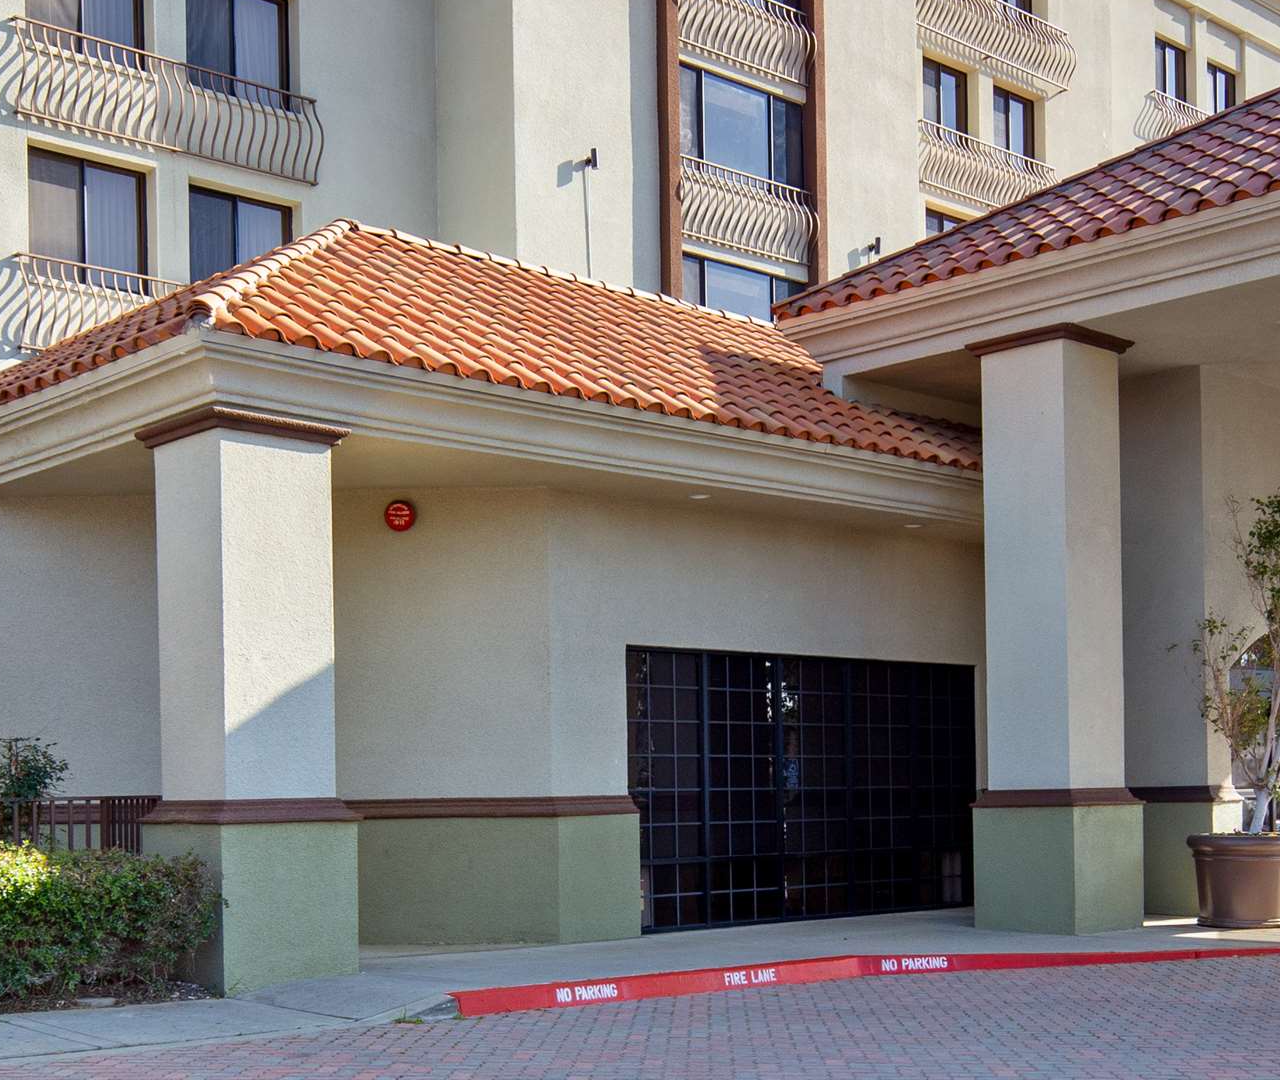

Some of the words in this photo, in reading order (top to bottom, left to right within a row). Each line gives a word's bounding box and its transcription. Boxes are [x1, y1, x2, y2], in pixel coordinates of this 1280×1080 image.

[881, 958, 898, 972] NO
[902, 956, 948, 970] PARKING
[724, 970, 748, 986] FIRE
[751, 968, 776, 983] LANE
[556, 987, 572, 1003] NO
[574, 983, 618, 1000] PARKING
